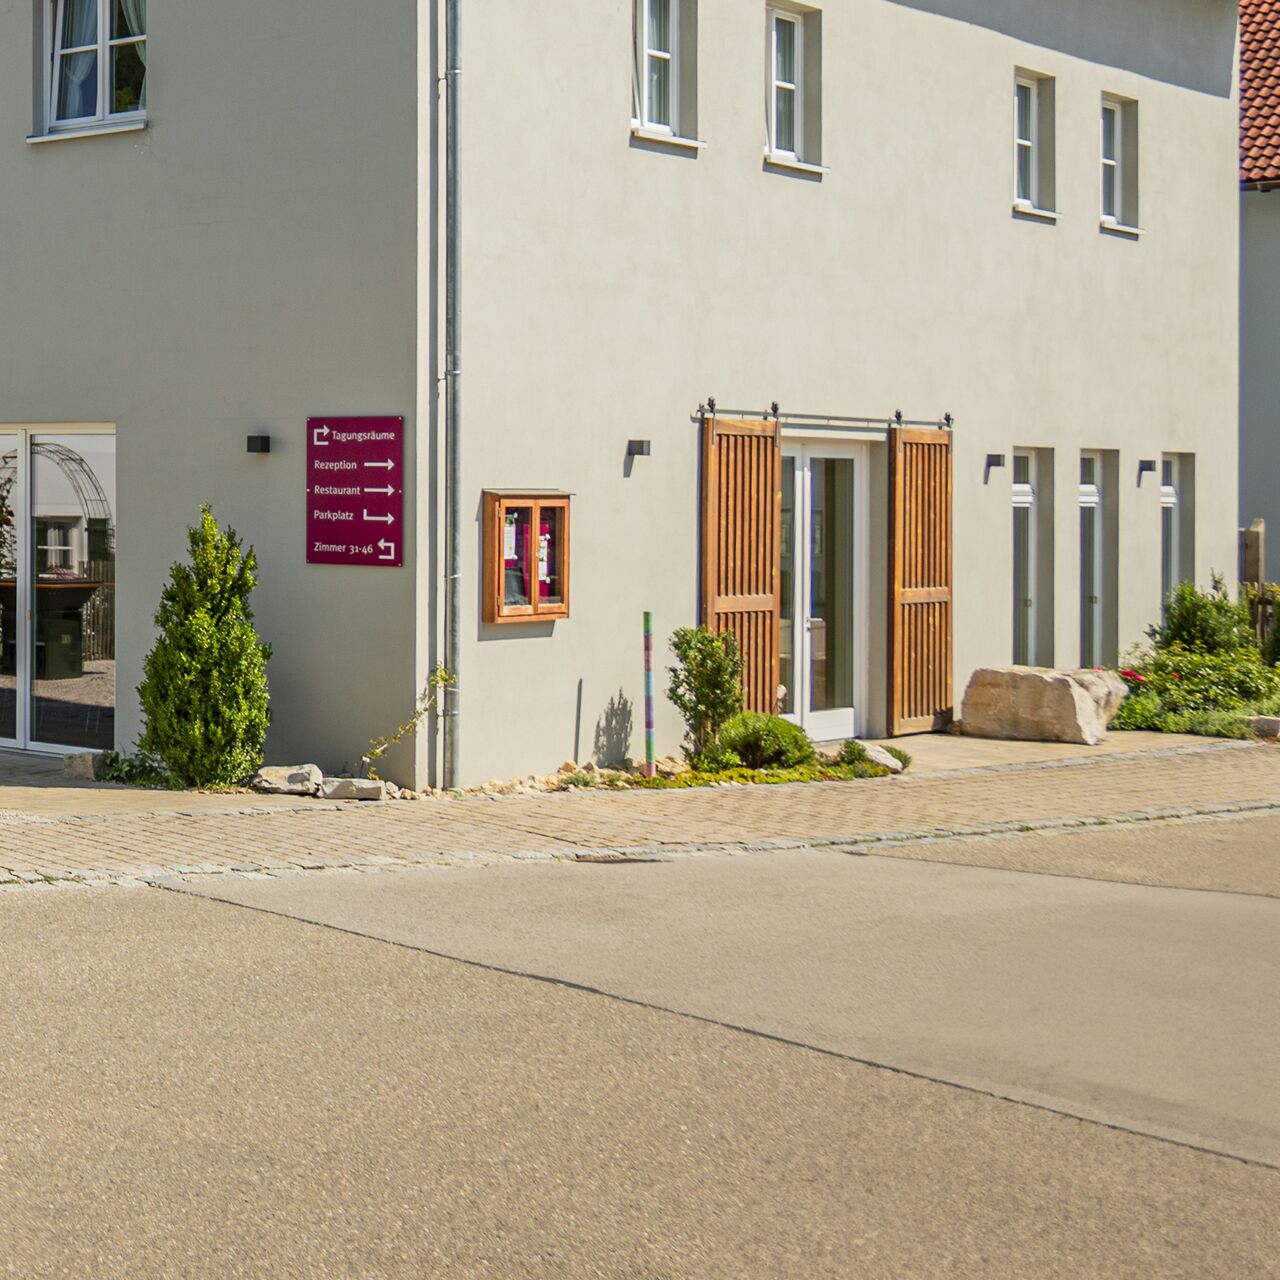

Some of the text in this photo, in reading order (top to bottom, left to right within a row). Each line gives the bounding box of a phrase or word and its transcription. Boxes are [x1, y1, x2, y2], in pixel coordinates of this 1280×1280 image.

[332, 430, 395, 442] Tagungsräume
[314, 460, 357, 471] Rezeption
[314, 485, 361, 495] Restaurant
[314, 510, 354, 522] Parkplatz
[314, 542, 346, 553] Zimmer
